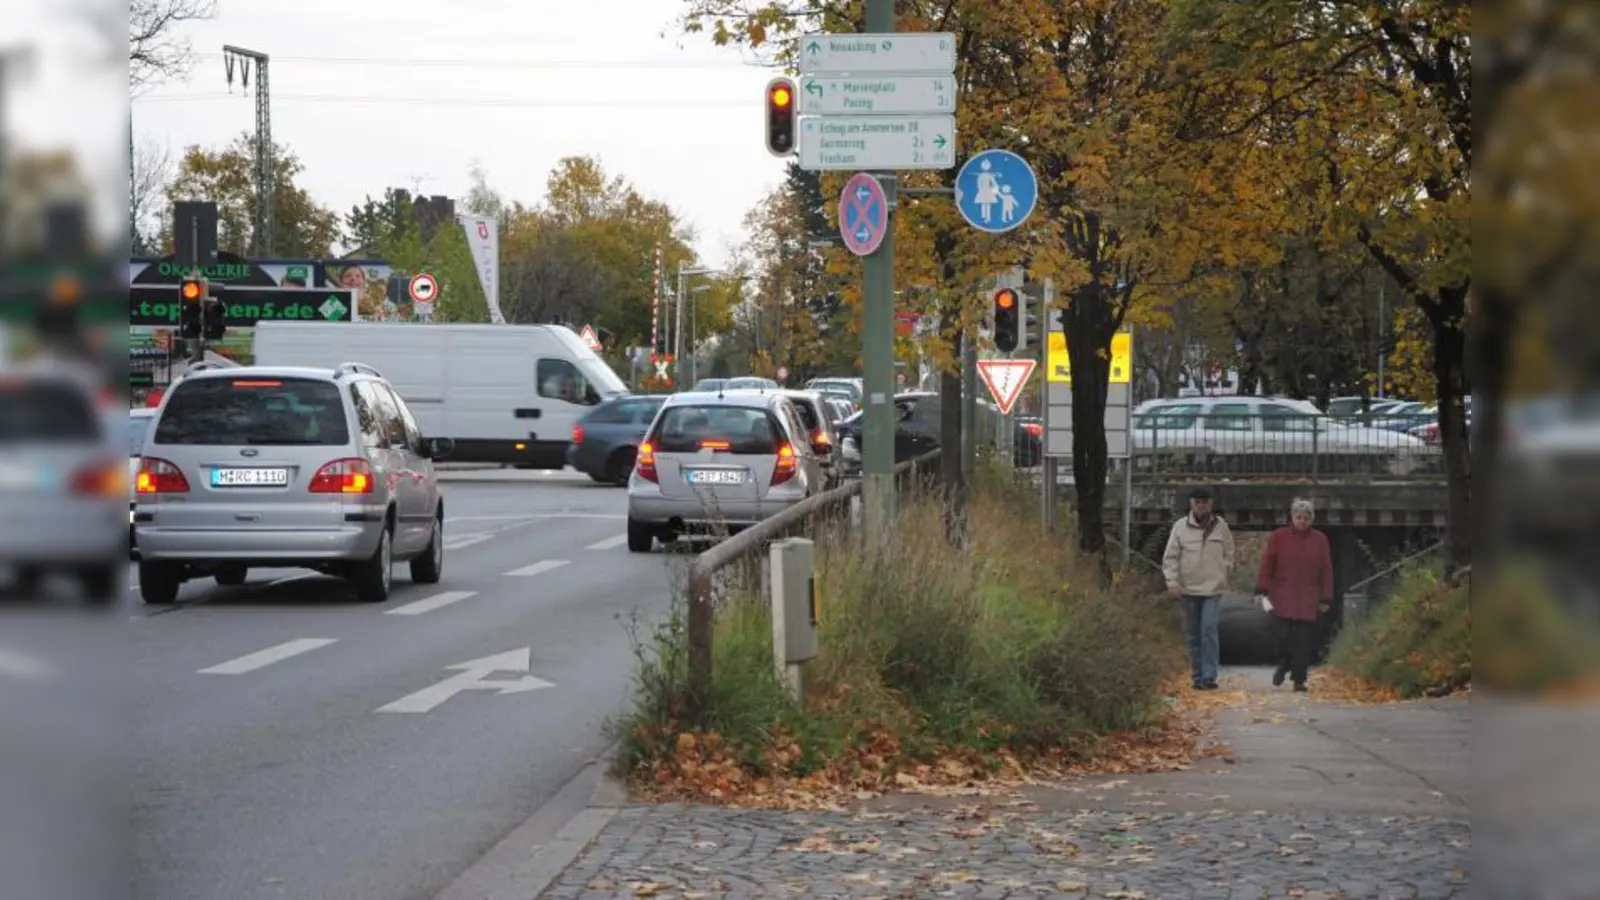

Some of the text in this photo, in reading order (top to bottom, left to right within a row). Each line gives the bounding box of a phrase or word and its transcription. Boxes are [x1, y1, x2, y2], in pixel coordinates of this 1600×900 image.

[843, 81, 896, 93] Marienplatz
[843, 97, 873, 109] Pasing
[820, 138, 865, 150] Germering
[820, 153, 856, 164] Freiham
[255, 470, 285, 482] 1110
